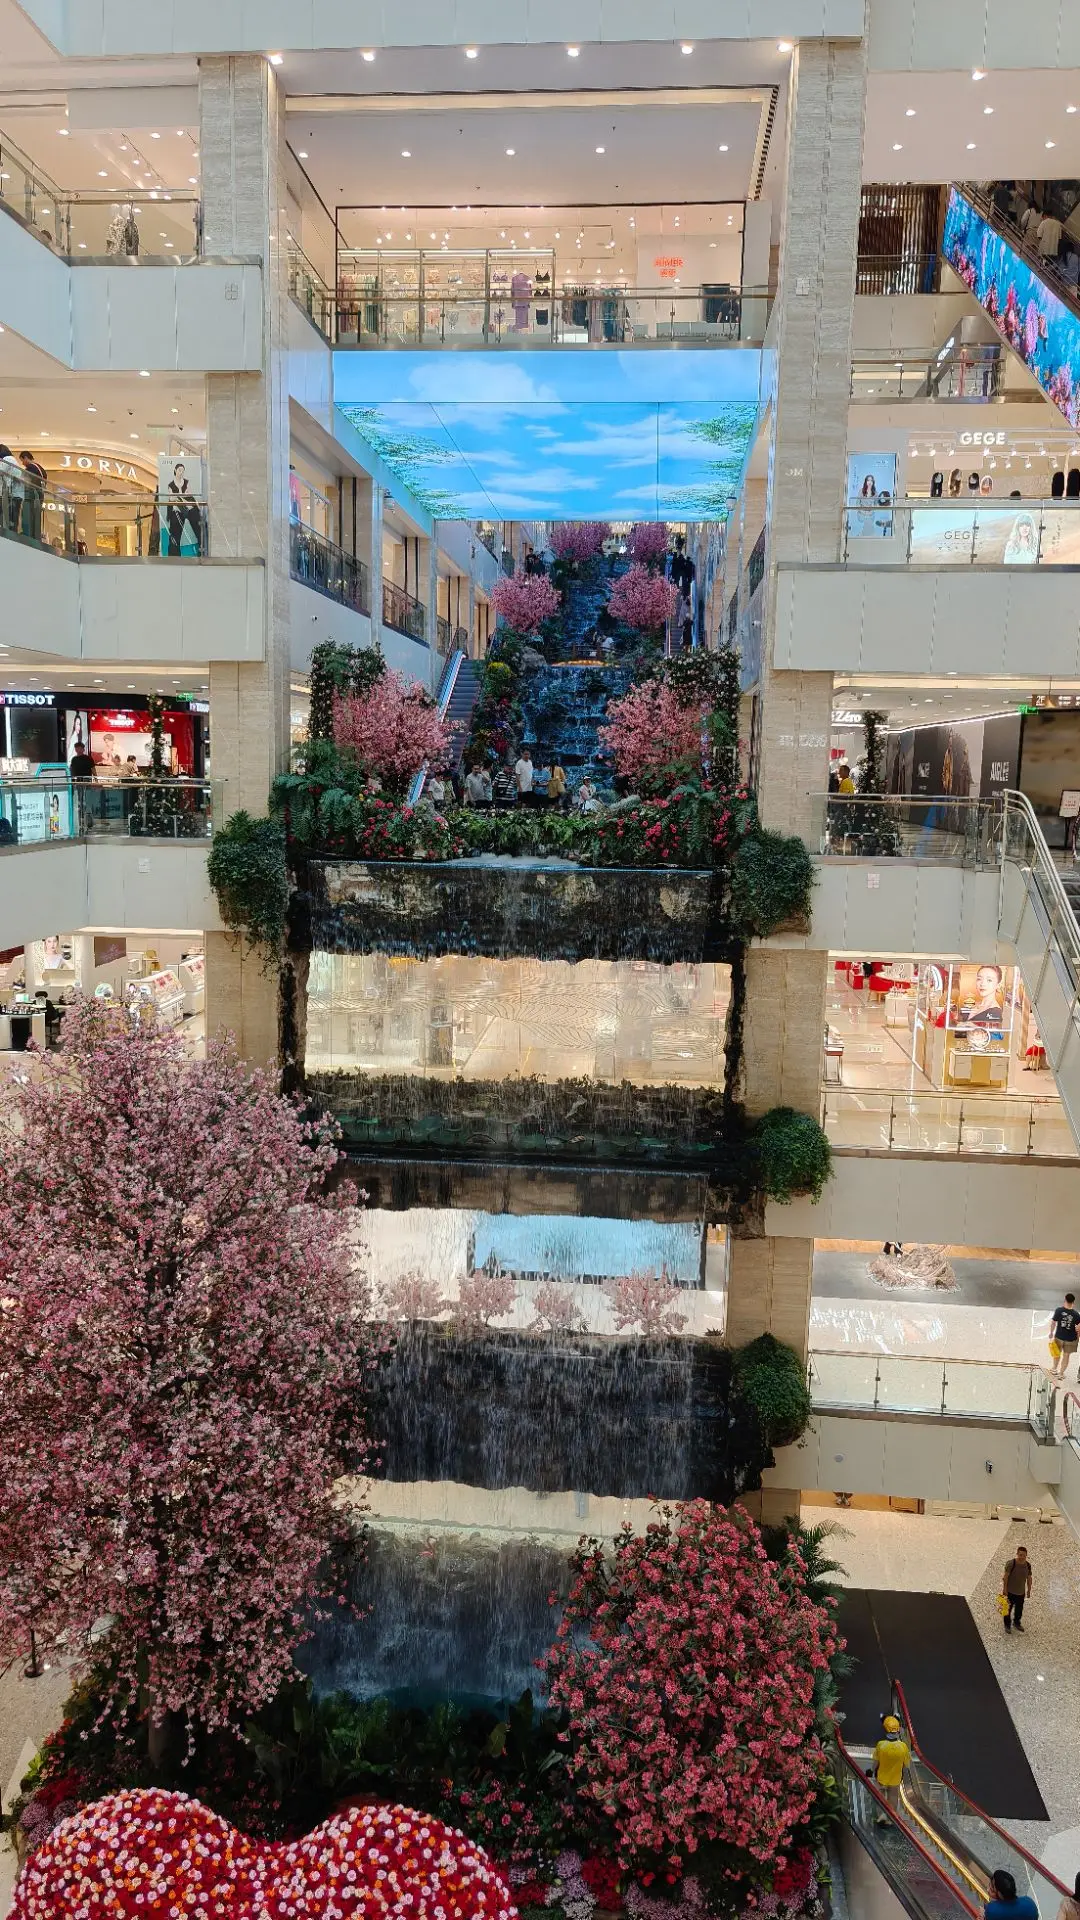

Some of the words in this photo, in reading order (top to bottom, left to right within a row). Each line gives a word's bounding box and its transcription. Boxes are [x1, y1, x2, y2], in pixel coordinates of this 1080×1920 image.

[960, 432, 1006, 445] GEGE
[60, 455, 138, 480] JORYA
[6, 694, 55, 705] TISSOT
